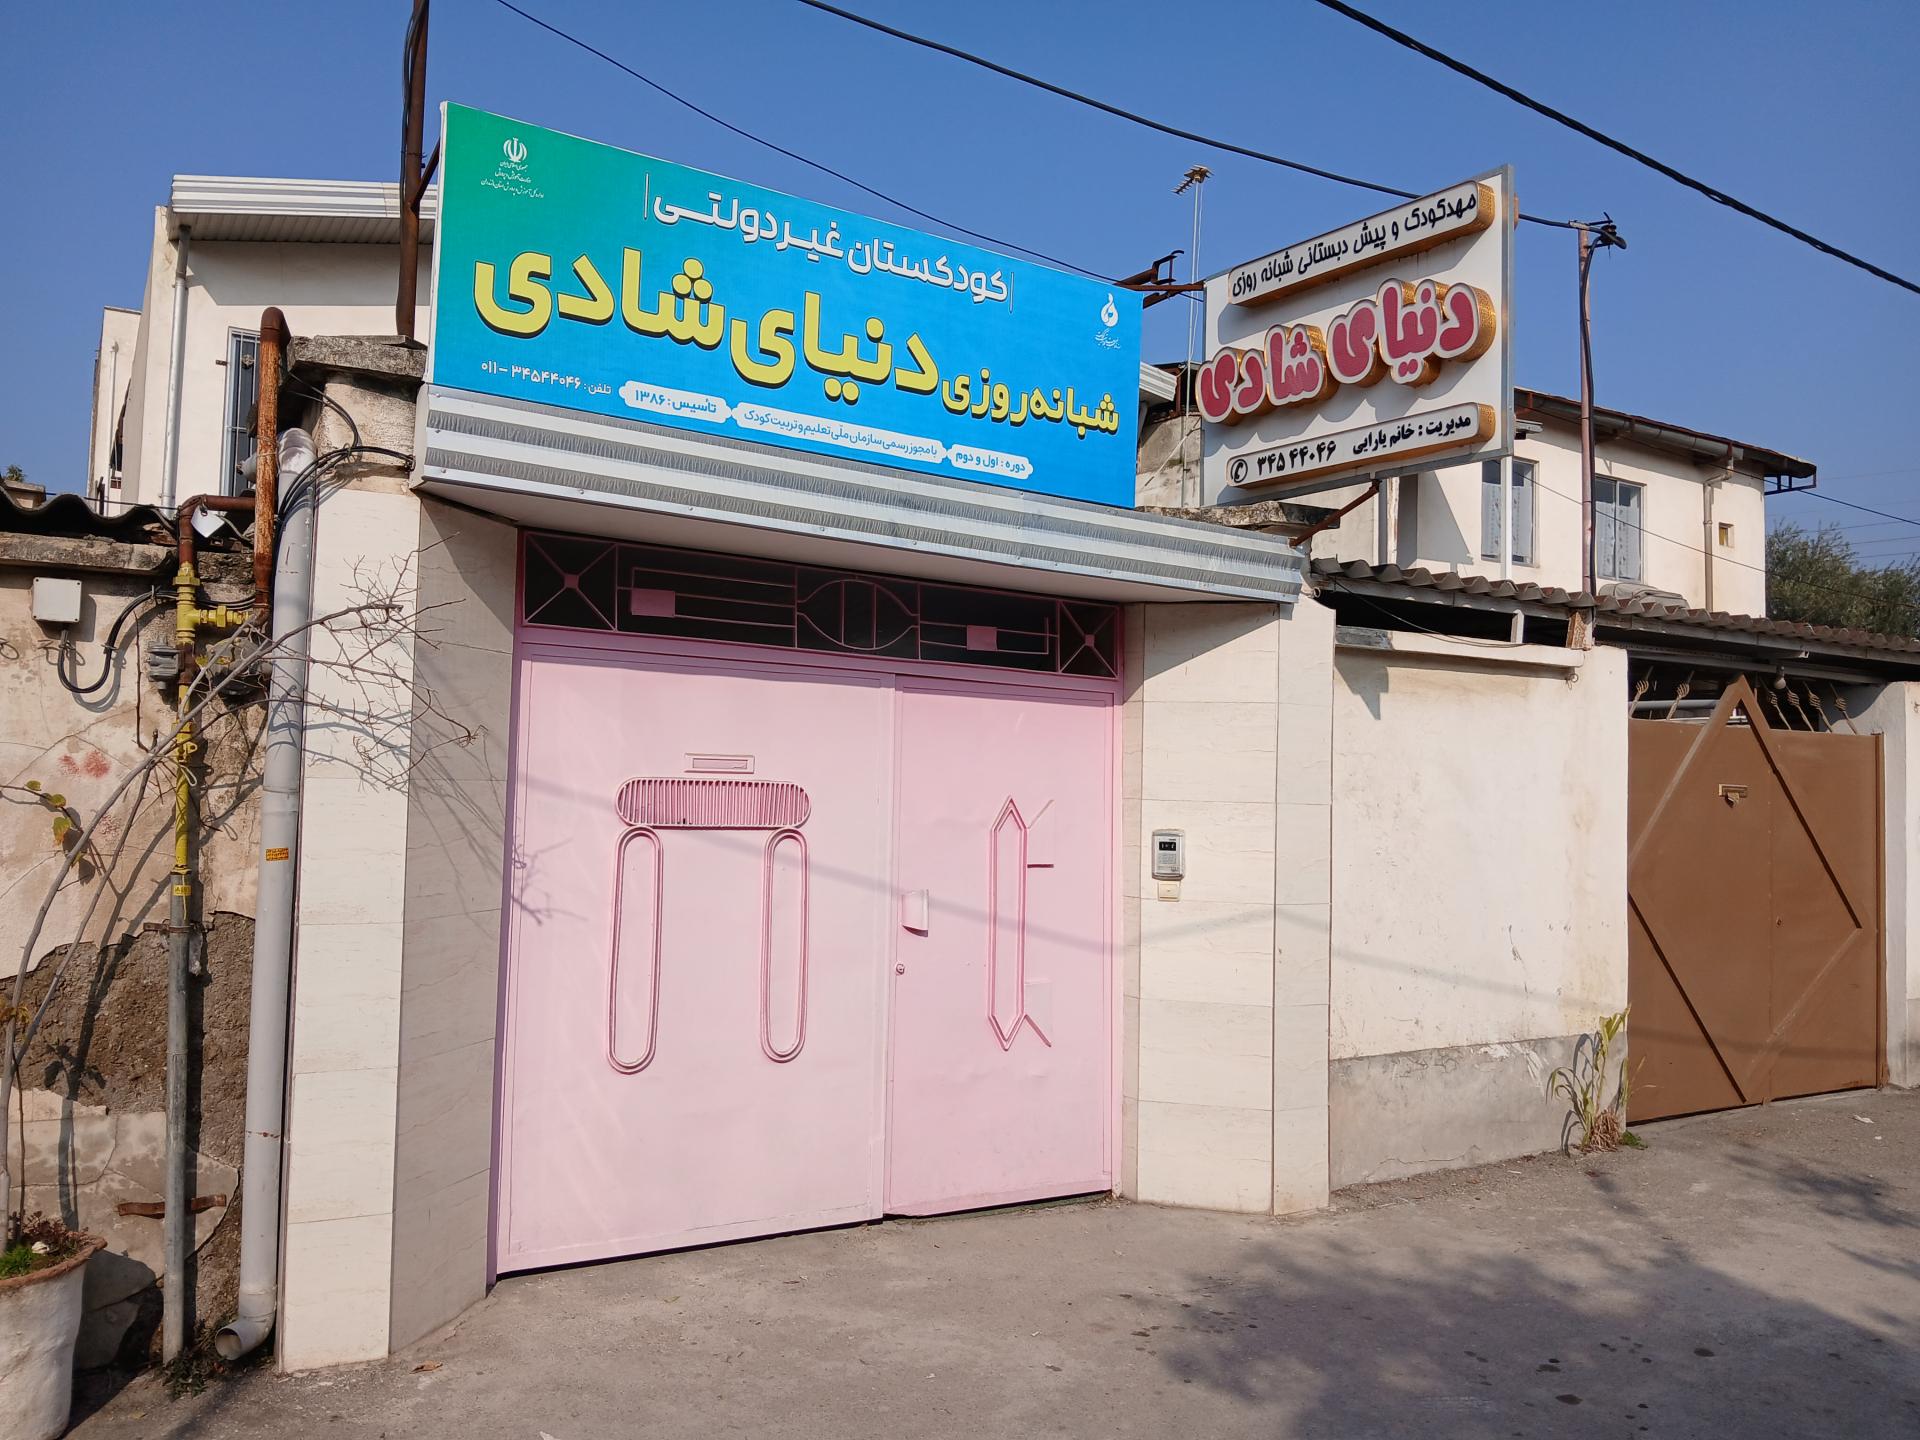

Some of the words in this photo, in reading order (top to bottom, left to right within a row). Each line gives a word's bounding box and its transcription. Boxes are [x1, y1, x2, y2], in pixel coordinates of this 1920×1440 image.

[1353, 221, 1386, 250] پیش
[1391, 220, 1399, 241] و
[1261, 251, 1294, 282] شبانه
[1298, 239, 1349, 275] دبستانی
[847, 238, 1008, 304] کودکستان
[1232, 271, 1257, 297] روزی
[473, 246, 726, 350] شادی
[1329, 281, 1477, 381] دنیای
[730, 290, 939, 405] دنیای
[1198, 327, 1321, 421] شادی
[634, 389, 665, 405] ۱۳۸۶
[744, 410, 771, 425] کودک
[771, 416, 798, 431] تربیت
[797, 423, 804, 433] و
[803, 423, 832, 436] تعلیم
[849, 431, 882, 446] سازمان
[1389, 426, 1415, 448] خانم
[882, 441, 909, 453] رسمی
[909, 443, 931, 456] مجوز
[1352, 431, 1387, 455] یارایی
[955, 451, 974, 463] دوم
[975, 456, 981, 466] و
[982, 454, 999, 468] اول
